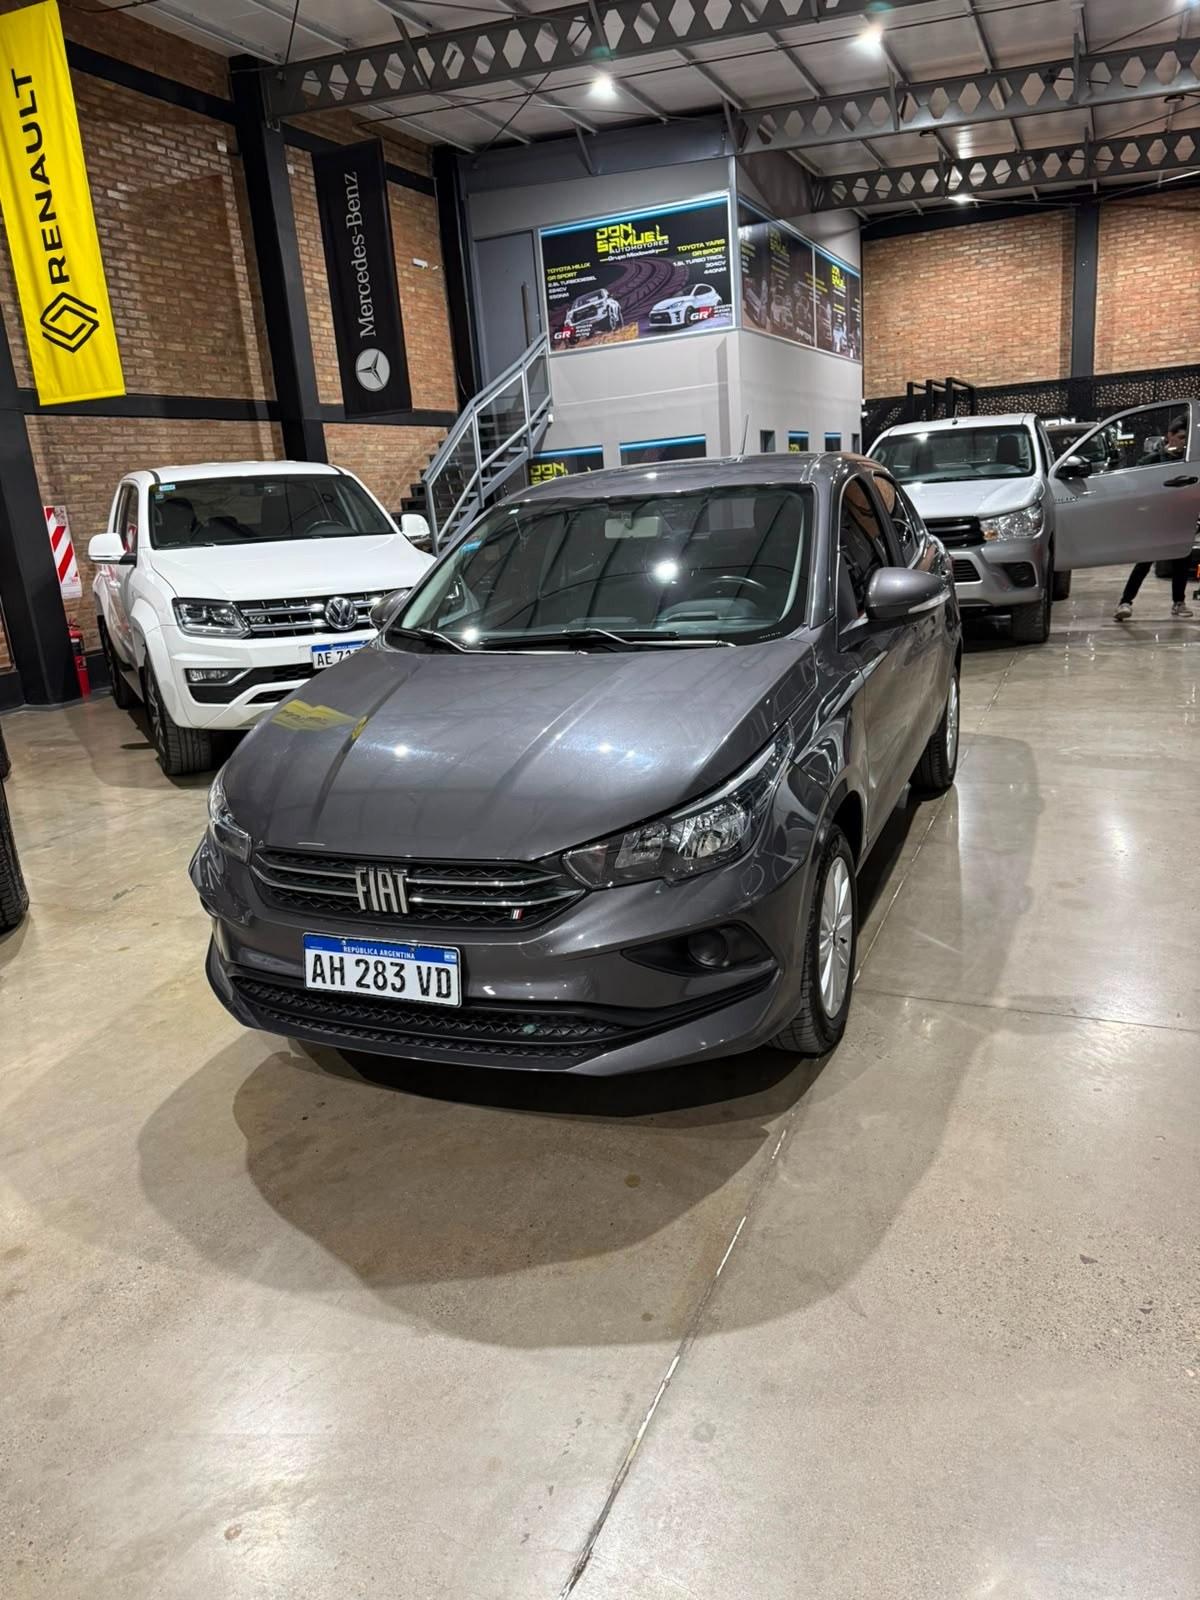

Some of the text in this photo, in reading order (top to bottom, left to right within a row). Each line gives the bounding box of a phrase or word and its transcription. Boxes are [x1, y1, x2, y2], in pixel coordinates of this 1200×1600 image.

[11, 68, 70, 285] RENAULT
[596, 222, 632, 240] DON
[597, 225, 669, 253] SAMUEL
[609, 239, 669, 254] AUTOMOTORES
[677, 242, 705, 251] TOYOTA
[344, 171, 377, 338] Mercedes-Benz
[547, 265, 571, 274] TOYOTA
[690, 311, 708, 320] GR
[554, 331, 571, 339] GR
[530, 462, 565, 477] DON
[317, 652, 333, 666] AE
[354, 867, 408, 913] FIAT
[343, 944, 415, 960] REPÚBLICA ARGENTINA
[311, 953, 451, 999] AH 283 VD
